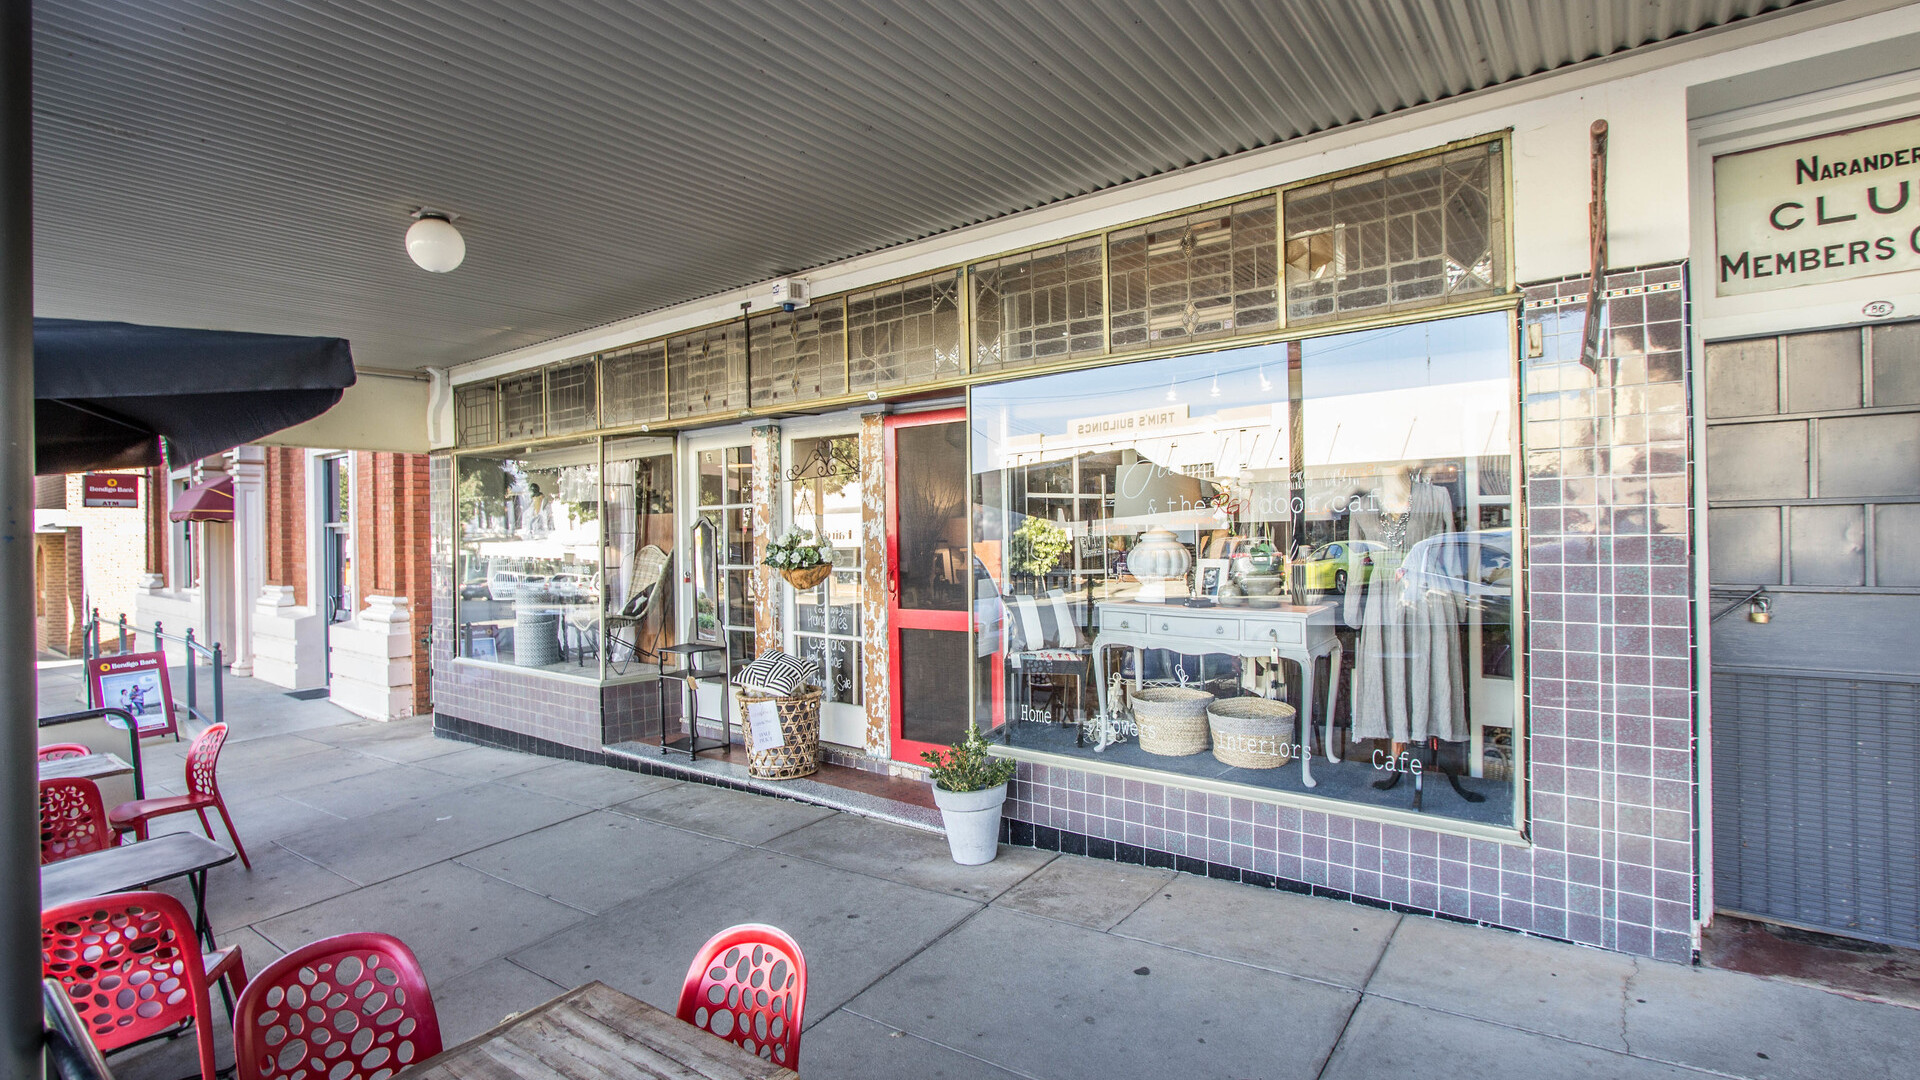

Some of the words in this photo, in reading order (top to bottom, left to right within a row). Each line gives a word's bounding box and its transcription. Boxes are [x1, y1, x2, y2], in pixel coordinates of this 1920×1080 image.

[1720, 237, 1896, 283] MEMBERS
[1167, 495, 1206, 515] the
[1210, 489, 1254, 515] Red
[1258, 491, 1319, 514] door
[1332, 487, 1382, 513] caf
[111, 660, 140, 670] Bendigo
[139, 658, 158, 666] Bank
[1021, 704, 1052, 724] Home
[1096, 714, 1157, 739] Flowers
[1217, 730, 1313, 761] Interiors
[1372, 749, 1423, 776] Cafe
